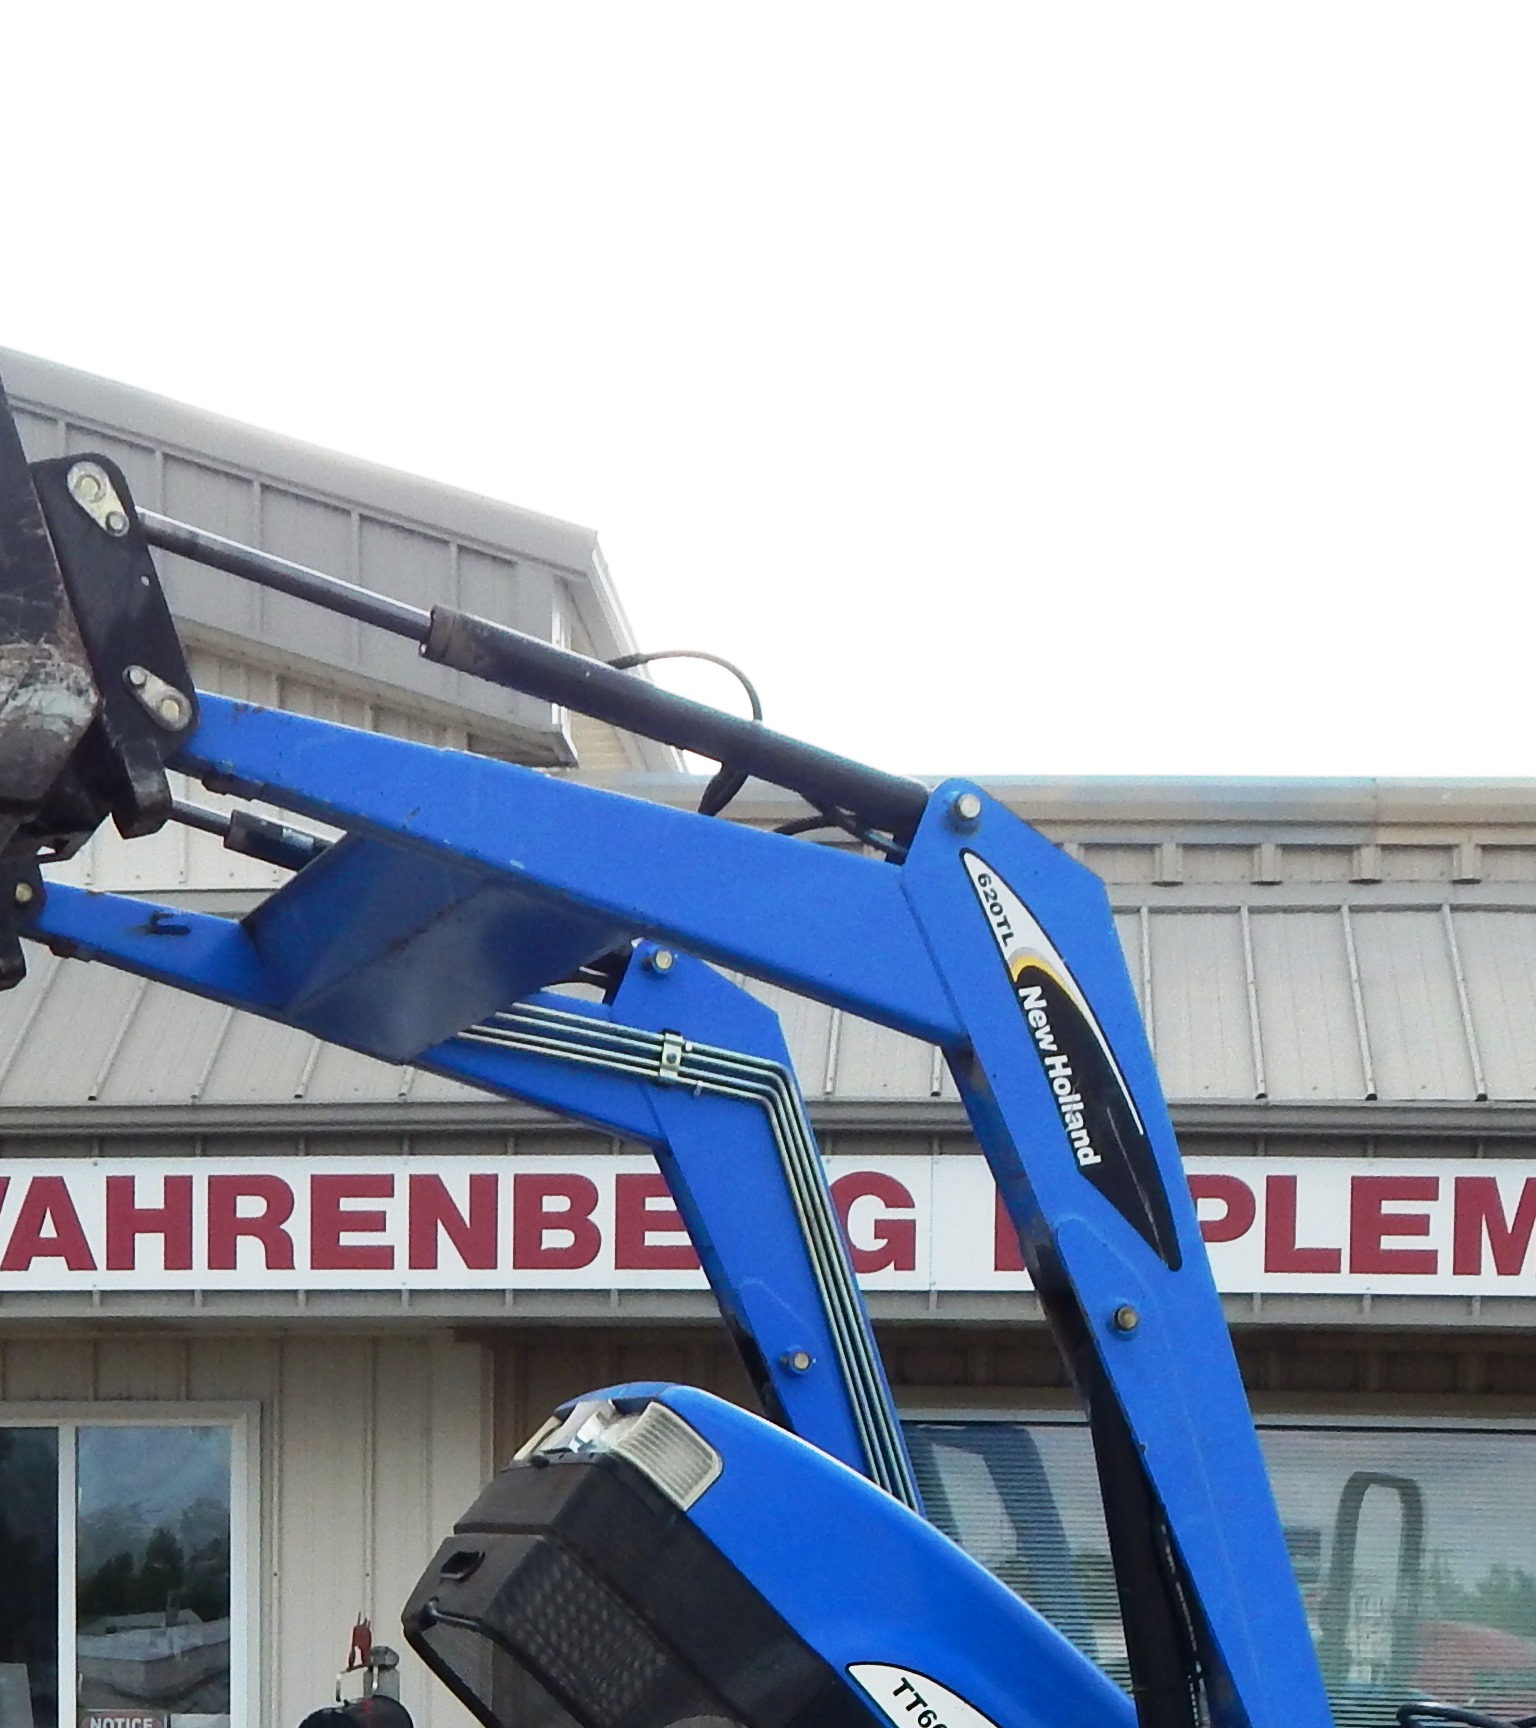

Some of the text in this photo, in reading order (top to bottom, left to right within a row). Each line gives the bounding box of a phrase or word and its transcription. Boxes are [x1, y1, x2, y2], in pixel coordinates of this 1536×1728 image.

[976, 872, 1016, 948] 620TL
[1018, 985, 1102, 1167] New Holland
